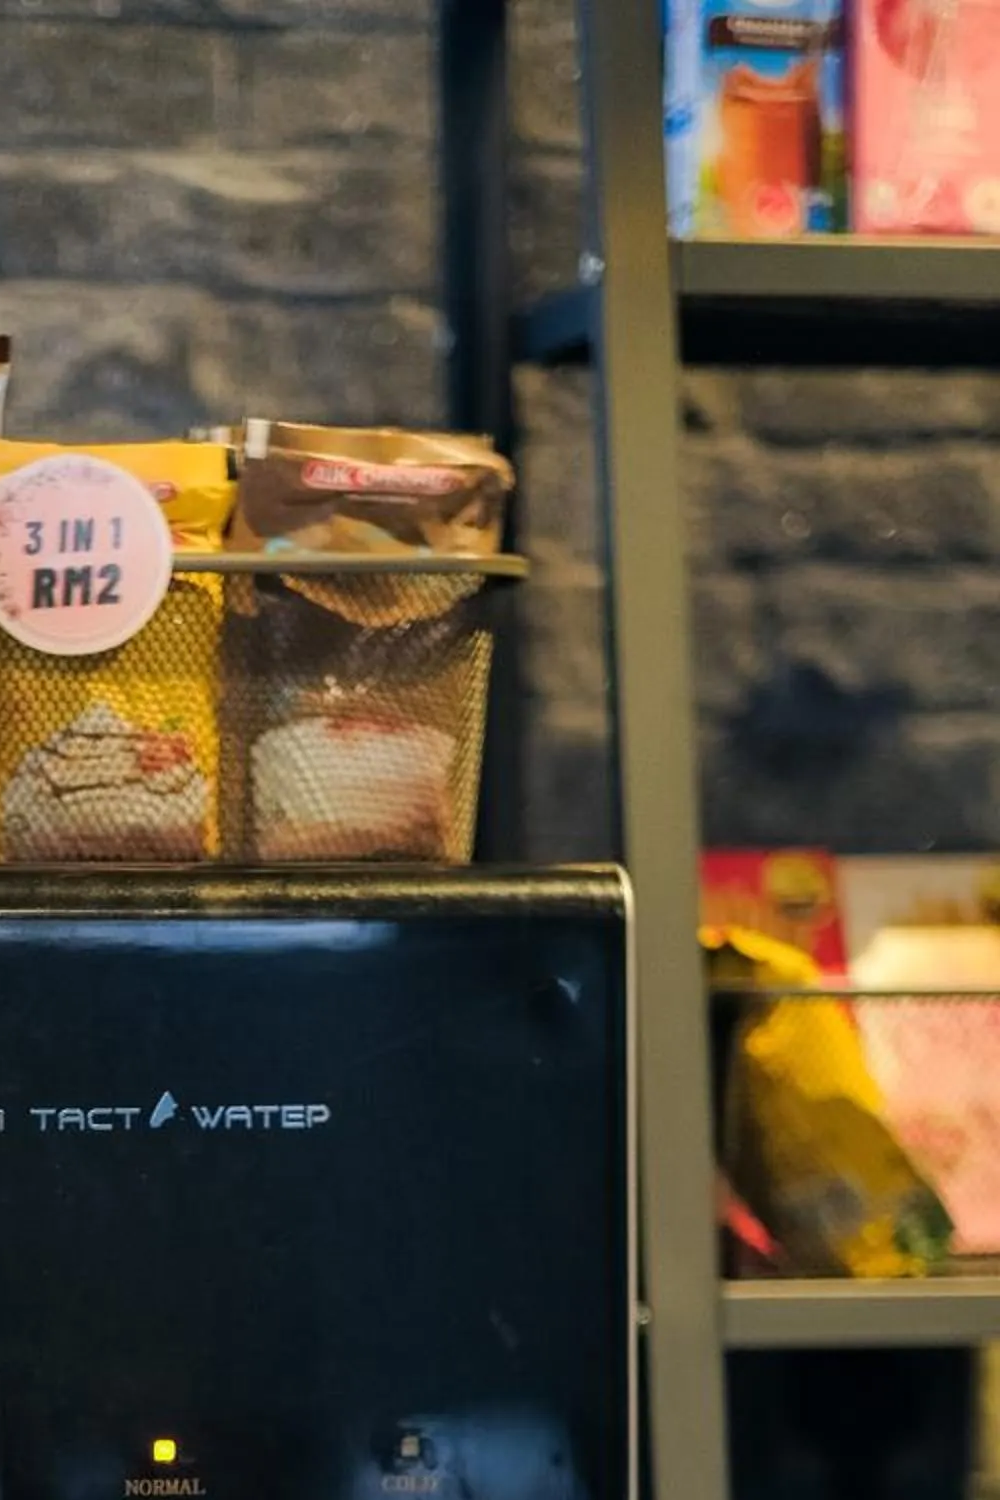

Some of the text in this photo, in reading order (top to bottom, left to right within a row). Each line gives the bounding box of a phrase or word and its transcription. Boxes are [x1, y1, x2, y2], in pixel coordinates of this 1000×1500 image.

[25, 517, 122, 555] 3 IN 1
[32, 563, 121, 609] RM2
[29, 1107, 142, 1131] TACT
[124, 1478, 207, 1496] NORMAL
